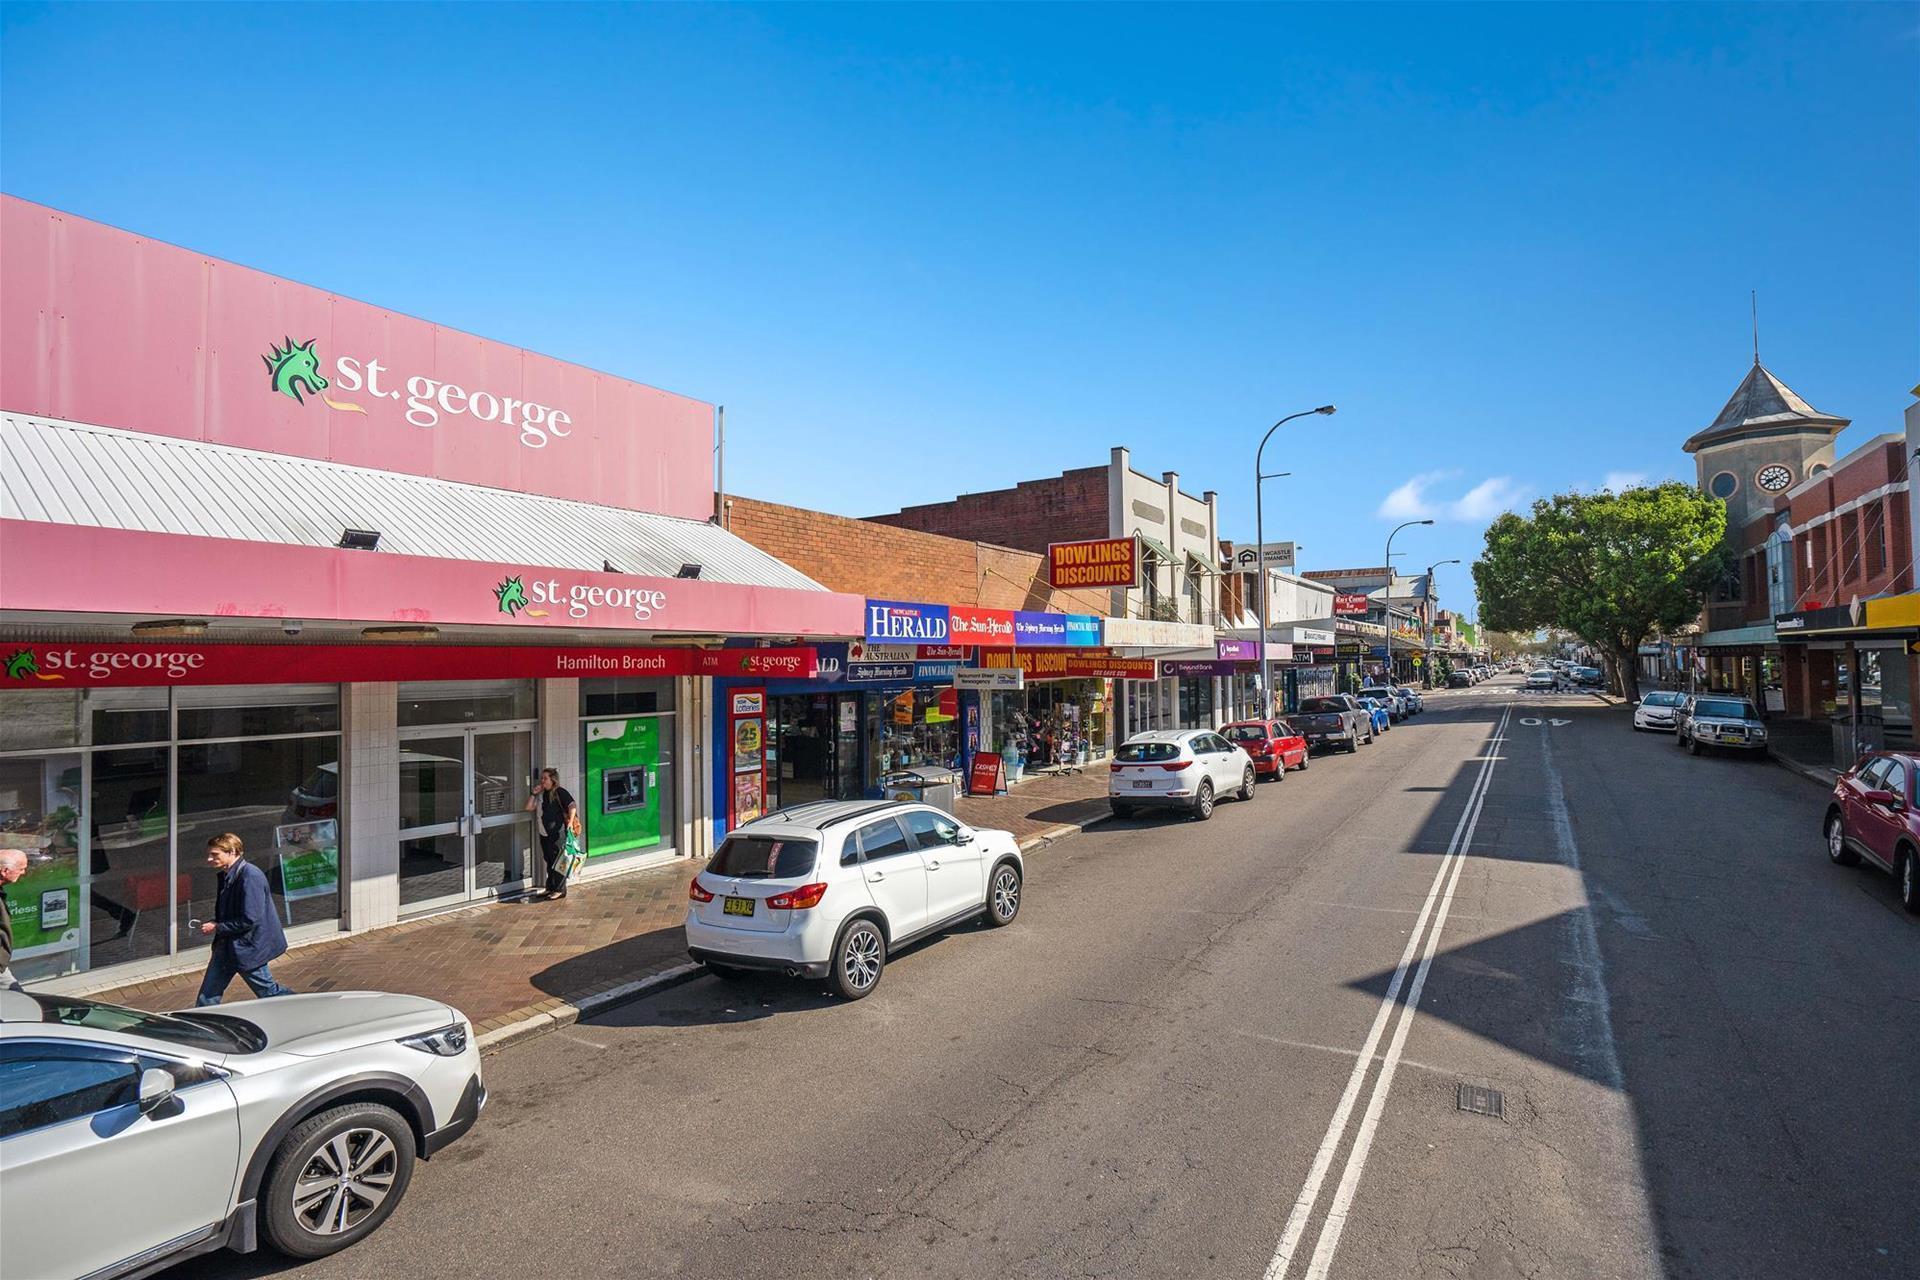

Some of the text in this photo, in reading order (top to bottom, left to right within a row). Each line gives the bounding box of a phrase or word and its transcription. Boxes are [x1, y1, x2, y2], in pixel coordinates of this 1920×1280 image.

[335, 356, 572, 448] st.george
[1055, 542, 1131, 566] DOWLINGS
[1056, 564, 1131, 585] DISCOUNTS
[531, 579, 666, 620] st.george
[870, 606, 947, 639] HERALD
[951, 615, 1013, 637] The Sun-Herald
[864, 651, 910, 661] AUSTRALIAN
[867, 644, 881, 652] THE
[937, 646, 963, 656] Sun-Heral
[45, 649, 205, 679] st.george
[557, 655, 666, 670] Hamilton Branch
[703, 657, 719, 666] ATM
[750, 656, 801, 672] st.george
[1068, 660, 1153, 671] DOWLINGS DISCOUNTS
[1293, 653, 1310, 662] ATM
[736, 703, 761, 713] Lotteries
[741, 727, 758, 743] 25
